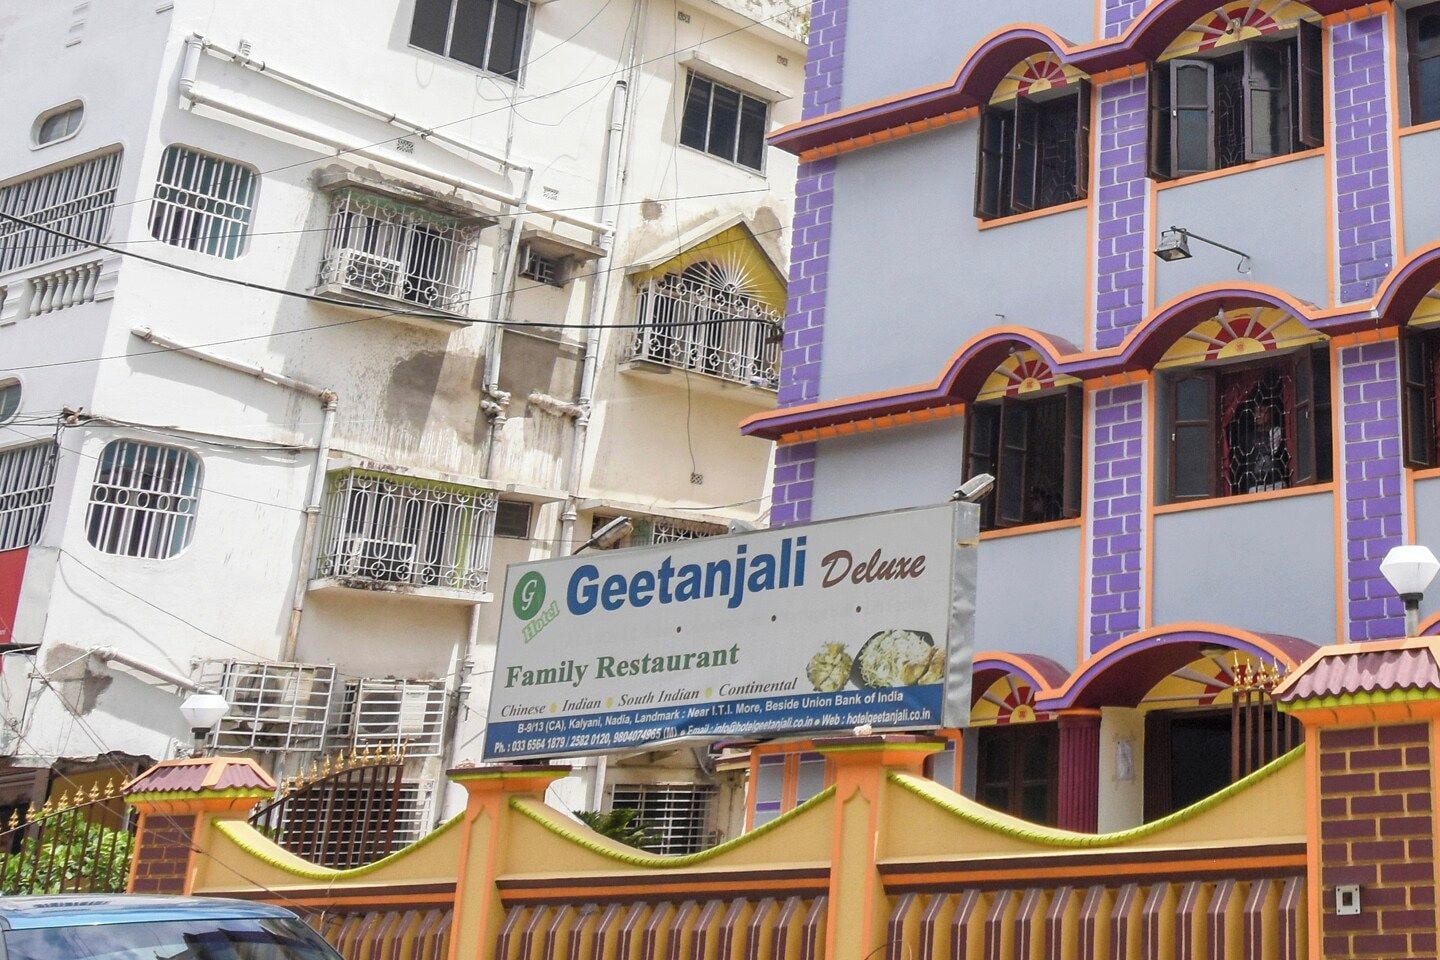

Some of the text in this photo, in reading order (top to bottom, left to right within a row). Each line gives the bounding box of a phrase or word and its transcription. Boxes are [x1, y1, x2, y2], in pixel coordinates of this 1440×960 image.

[567, 536, 926, 616] Geetanjali Deluxe
[522, 600, 561, 644] Hotel
[504, 643, 741, 688] Family Restaurant
[501, 677, 798, 718] Chinese Indian South Indian Continental
[634, 709, 680, 723] Landmark
[687, 707, 710, 718] Near
[735, 702, 763, 714] More,
[765, 698, 800, 712] Beside
[802, 696, 832, 708] Union
[835, 694, 861, 706] Bank
[864, 693, 876, 704] of
[878, 690, 904, 702] India
[822, 714, 840, 726] Web
